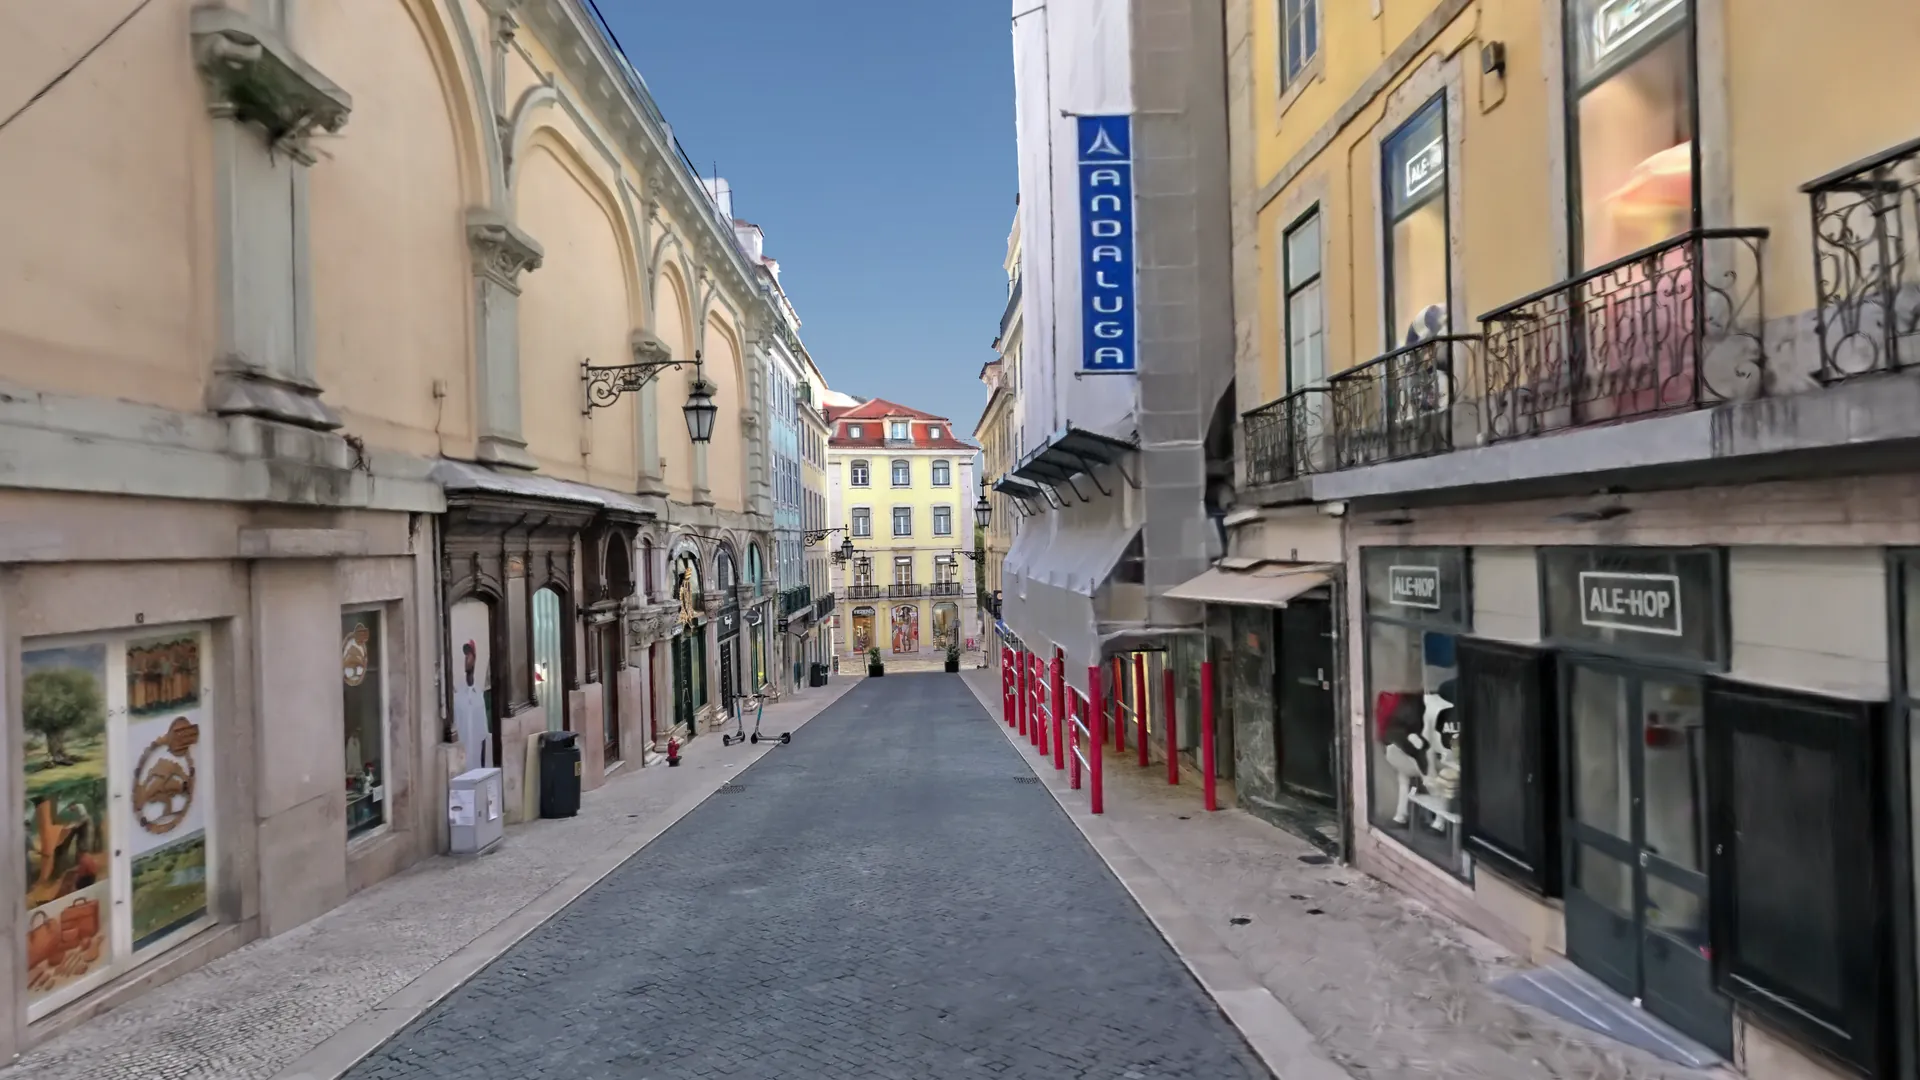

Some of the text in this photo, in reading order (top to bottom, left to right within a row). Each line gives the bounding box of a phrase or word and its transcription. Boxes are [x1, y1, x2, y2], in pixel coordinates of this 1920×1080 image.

[1090, 169, 1124, 364] ANDALUGA
[1394, 576, 1435, 597] ALE-HOP
[1590, 587, 1670, 618] ALE-HOP
